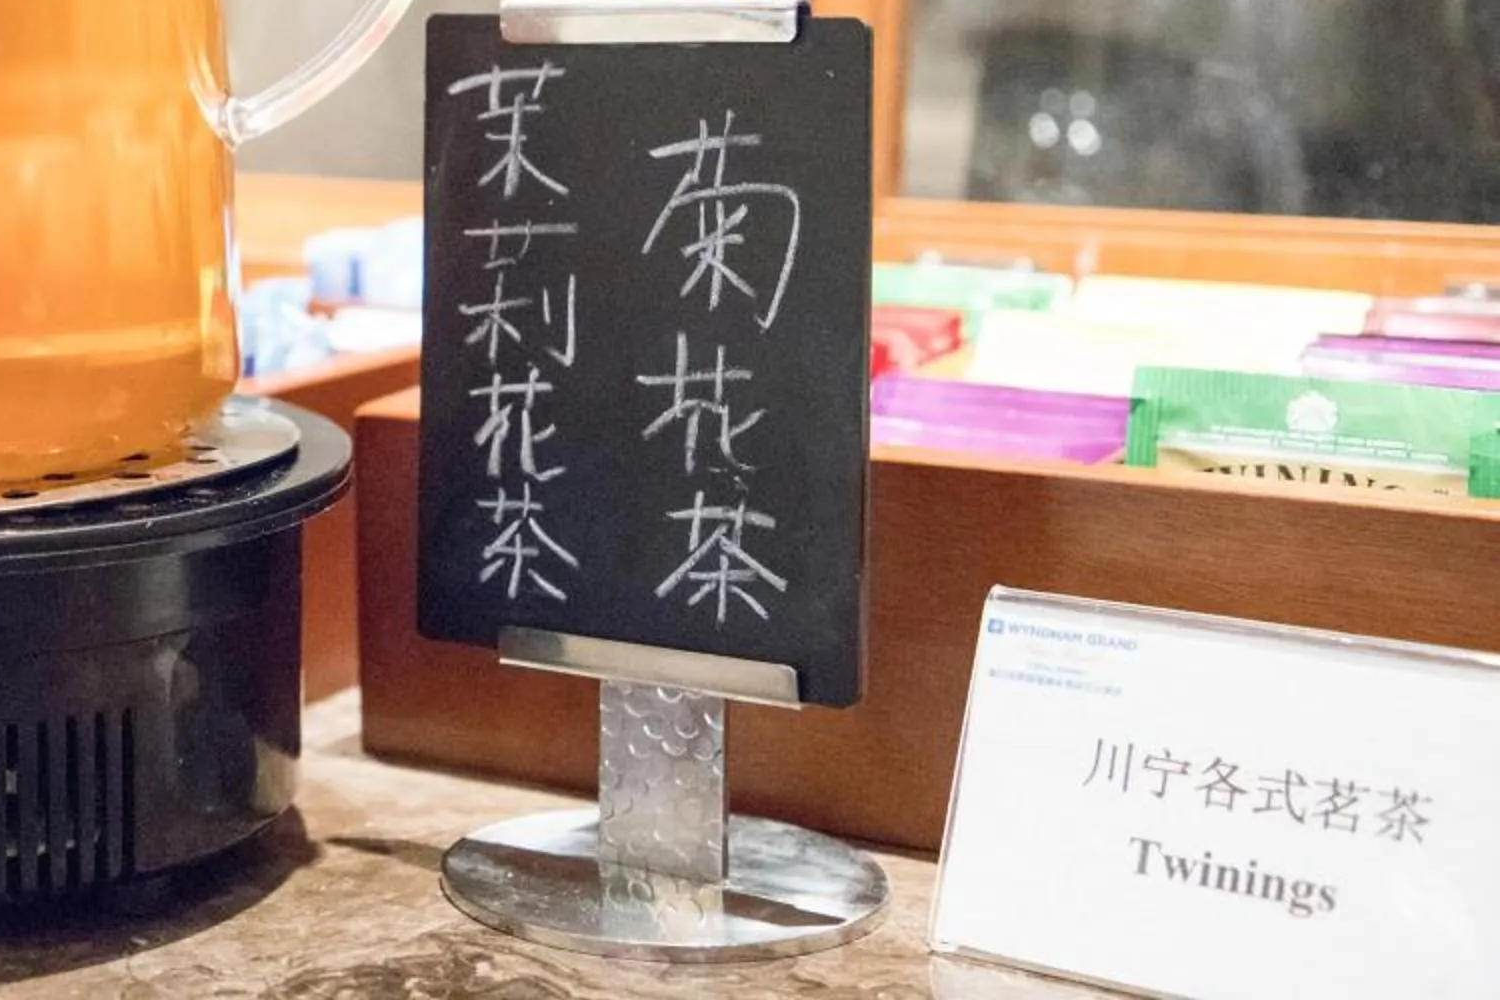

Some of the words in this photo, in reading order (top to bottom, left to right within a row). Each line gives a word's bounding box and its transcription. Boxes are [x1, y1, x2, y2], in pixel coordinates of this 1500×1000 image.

[448, 60, 579, 600] 茉莉花茶
[634, 109, 801, 630] 菊花茶
[1082, 737, 1434, 845] 川宁各式茗茶
[1128, 836, 1338, 920] Twinings
